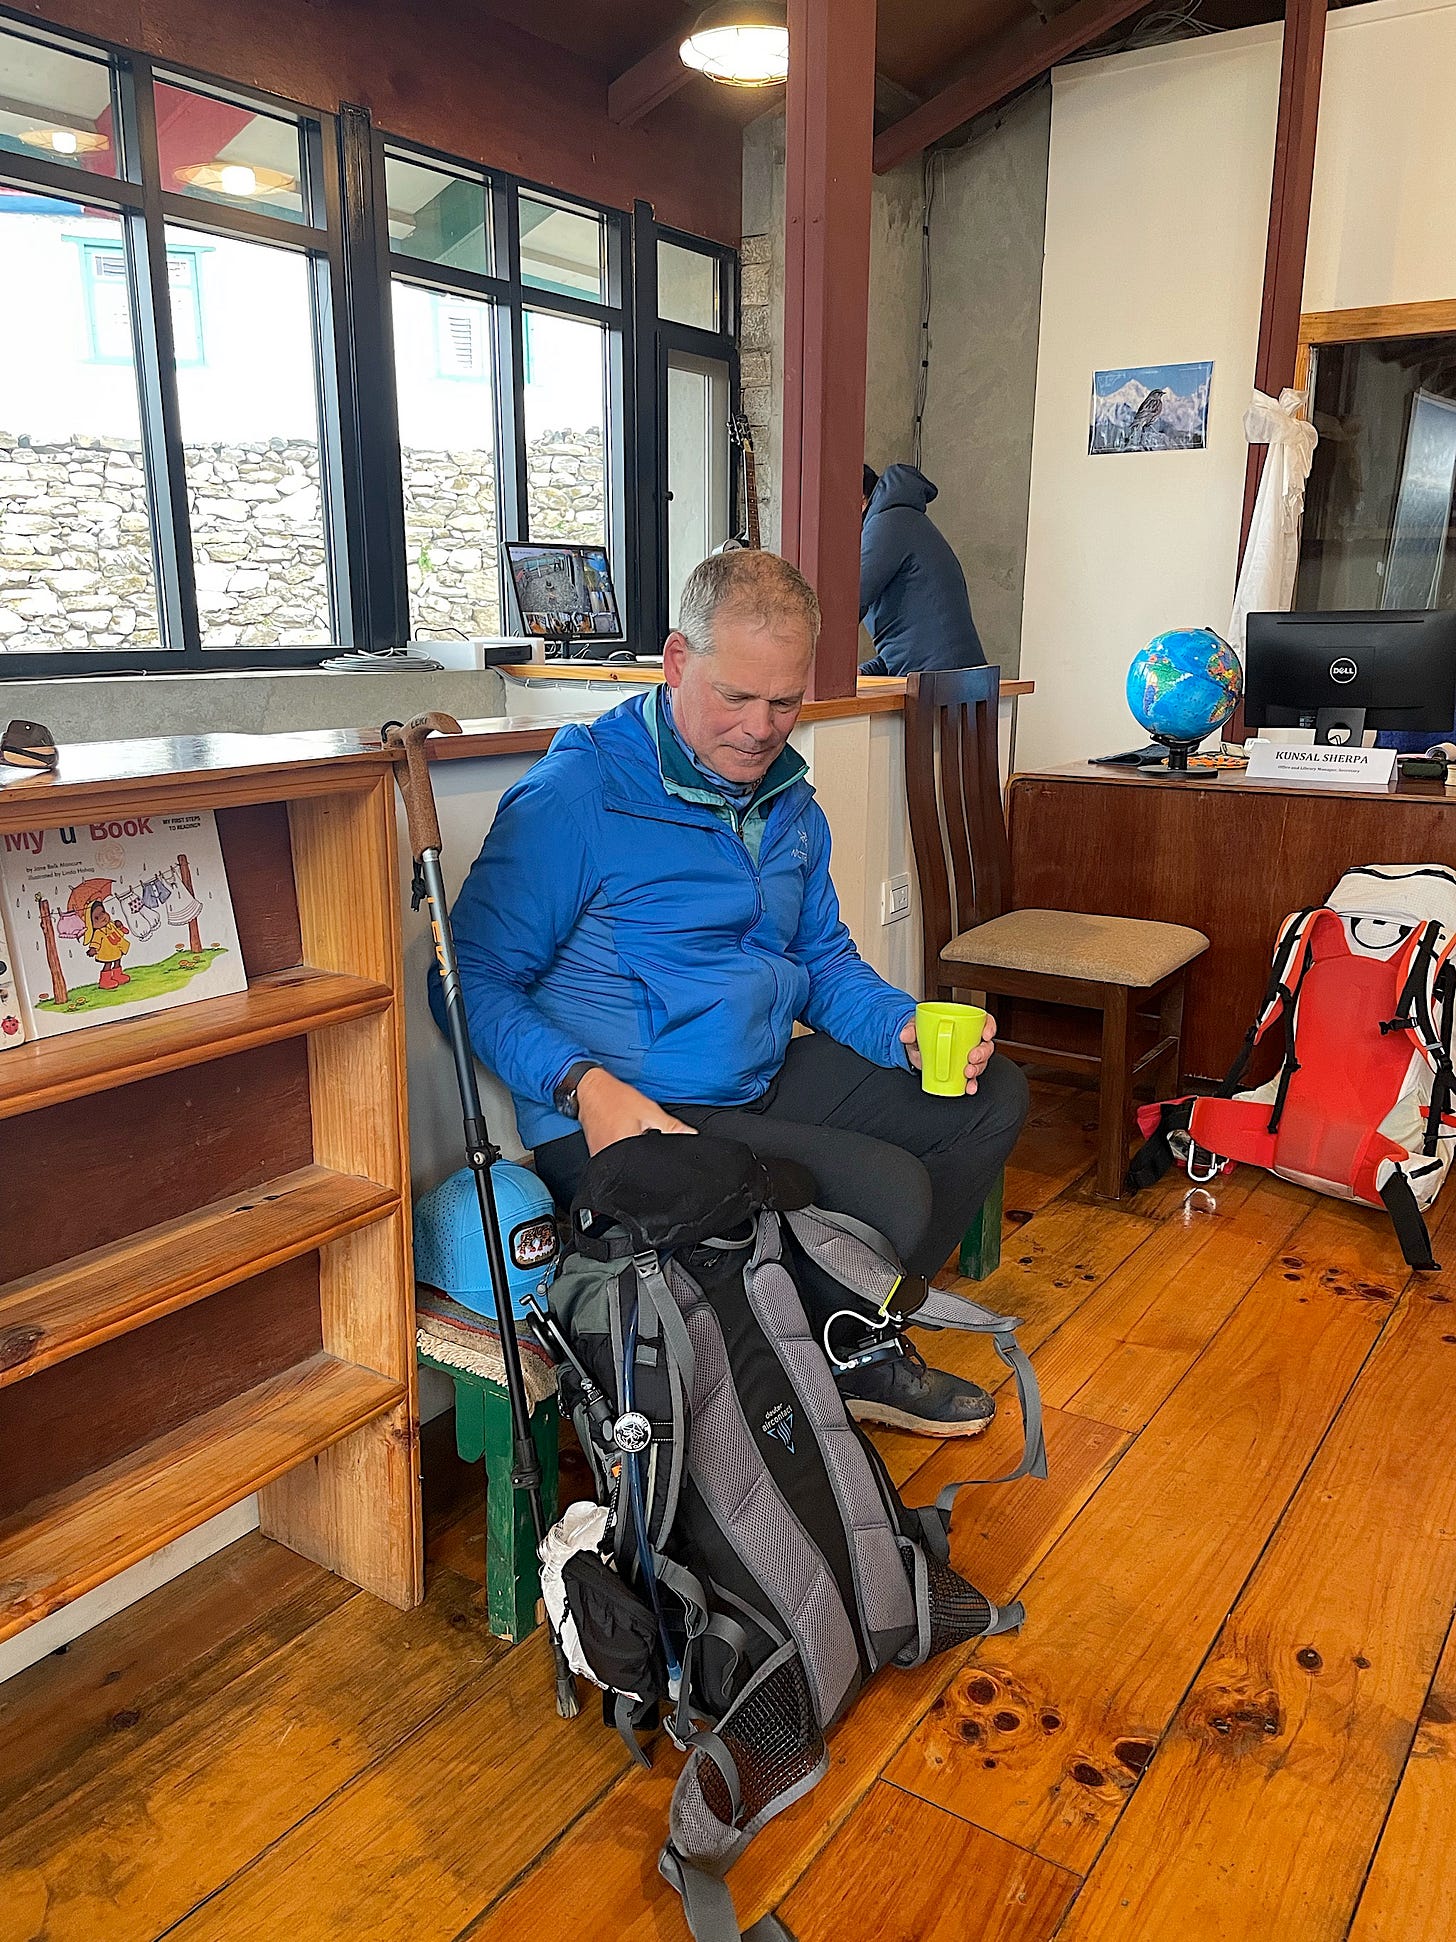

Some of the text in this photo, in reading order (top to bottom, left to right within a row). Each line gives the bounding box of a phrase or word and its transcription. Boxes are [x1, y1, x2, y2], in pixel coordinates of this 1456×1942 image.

[1333, 667, 1354, 675] DELL
[1275, 751, 1368, 764] KUNSAL SHERPA
[4, 816, 154, 855] My u Book
